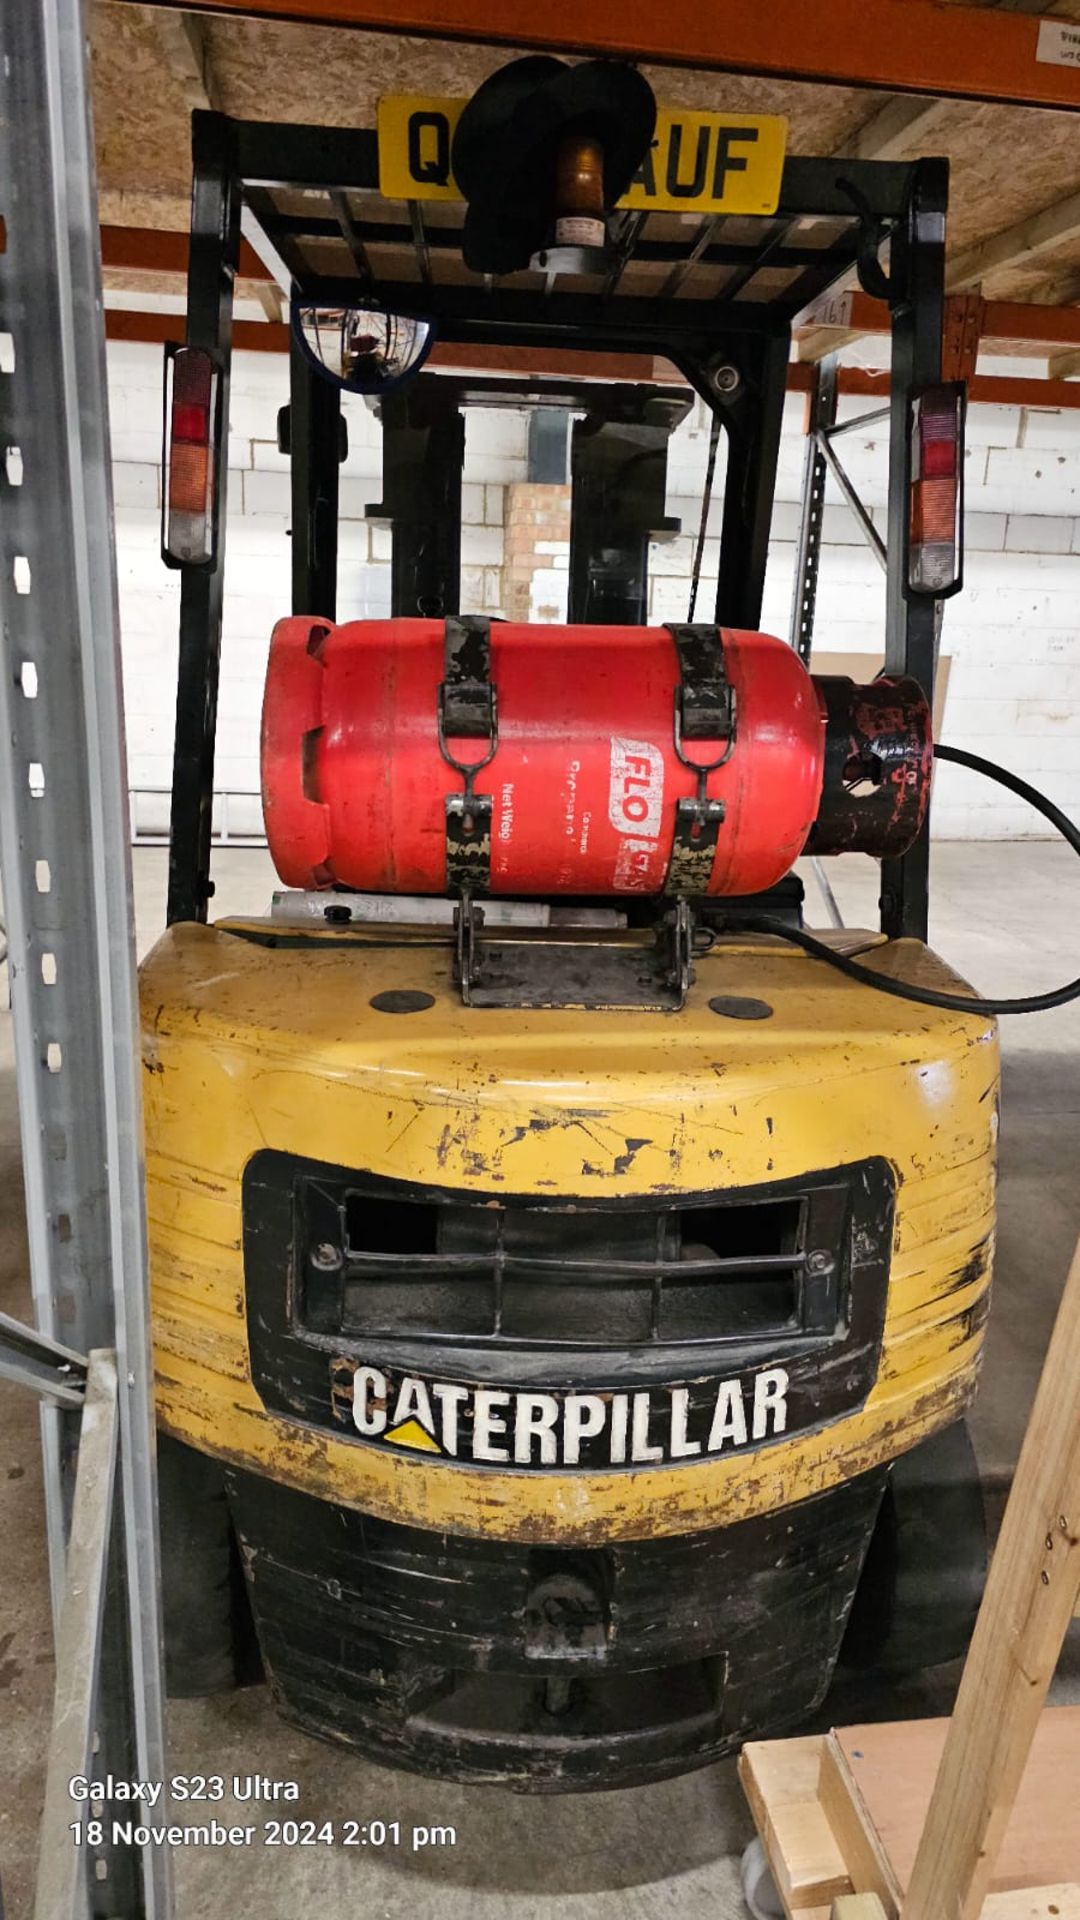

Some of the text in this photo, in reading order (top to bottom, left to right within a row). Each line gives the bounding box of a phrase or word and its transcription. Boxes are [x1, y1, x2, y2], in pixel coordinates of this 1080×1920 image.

[408, 111, 449, 186] Q
[501, 783, 515, 808] Net
[622, 755, 652, 823] FLO
[351, 1367, 790, 1467] CATERPILLAR
